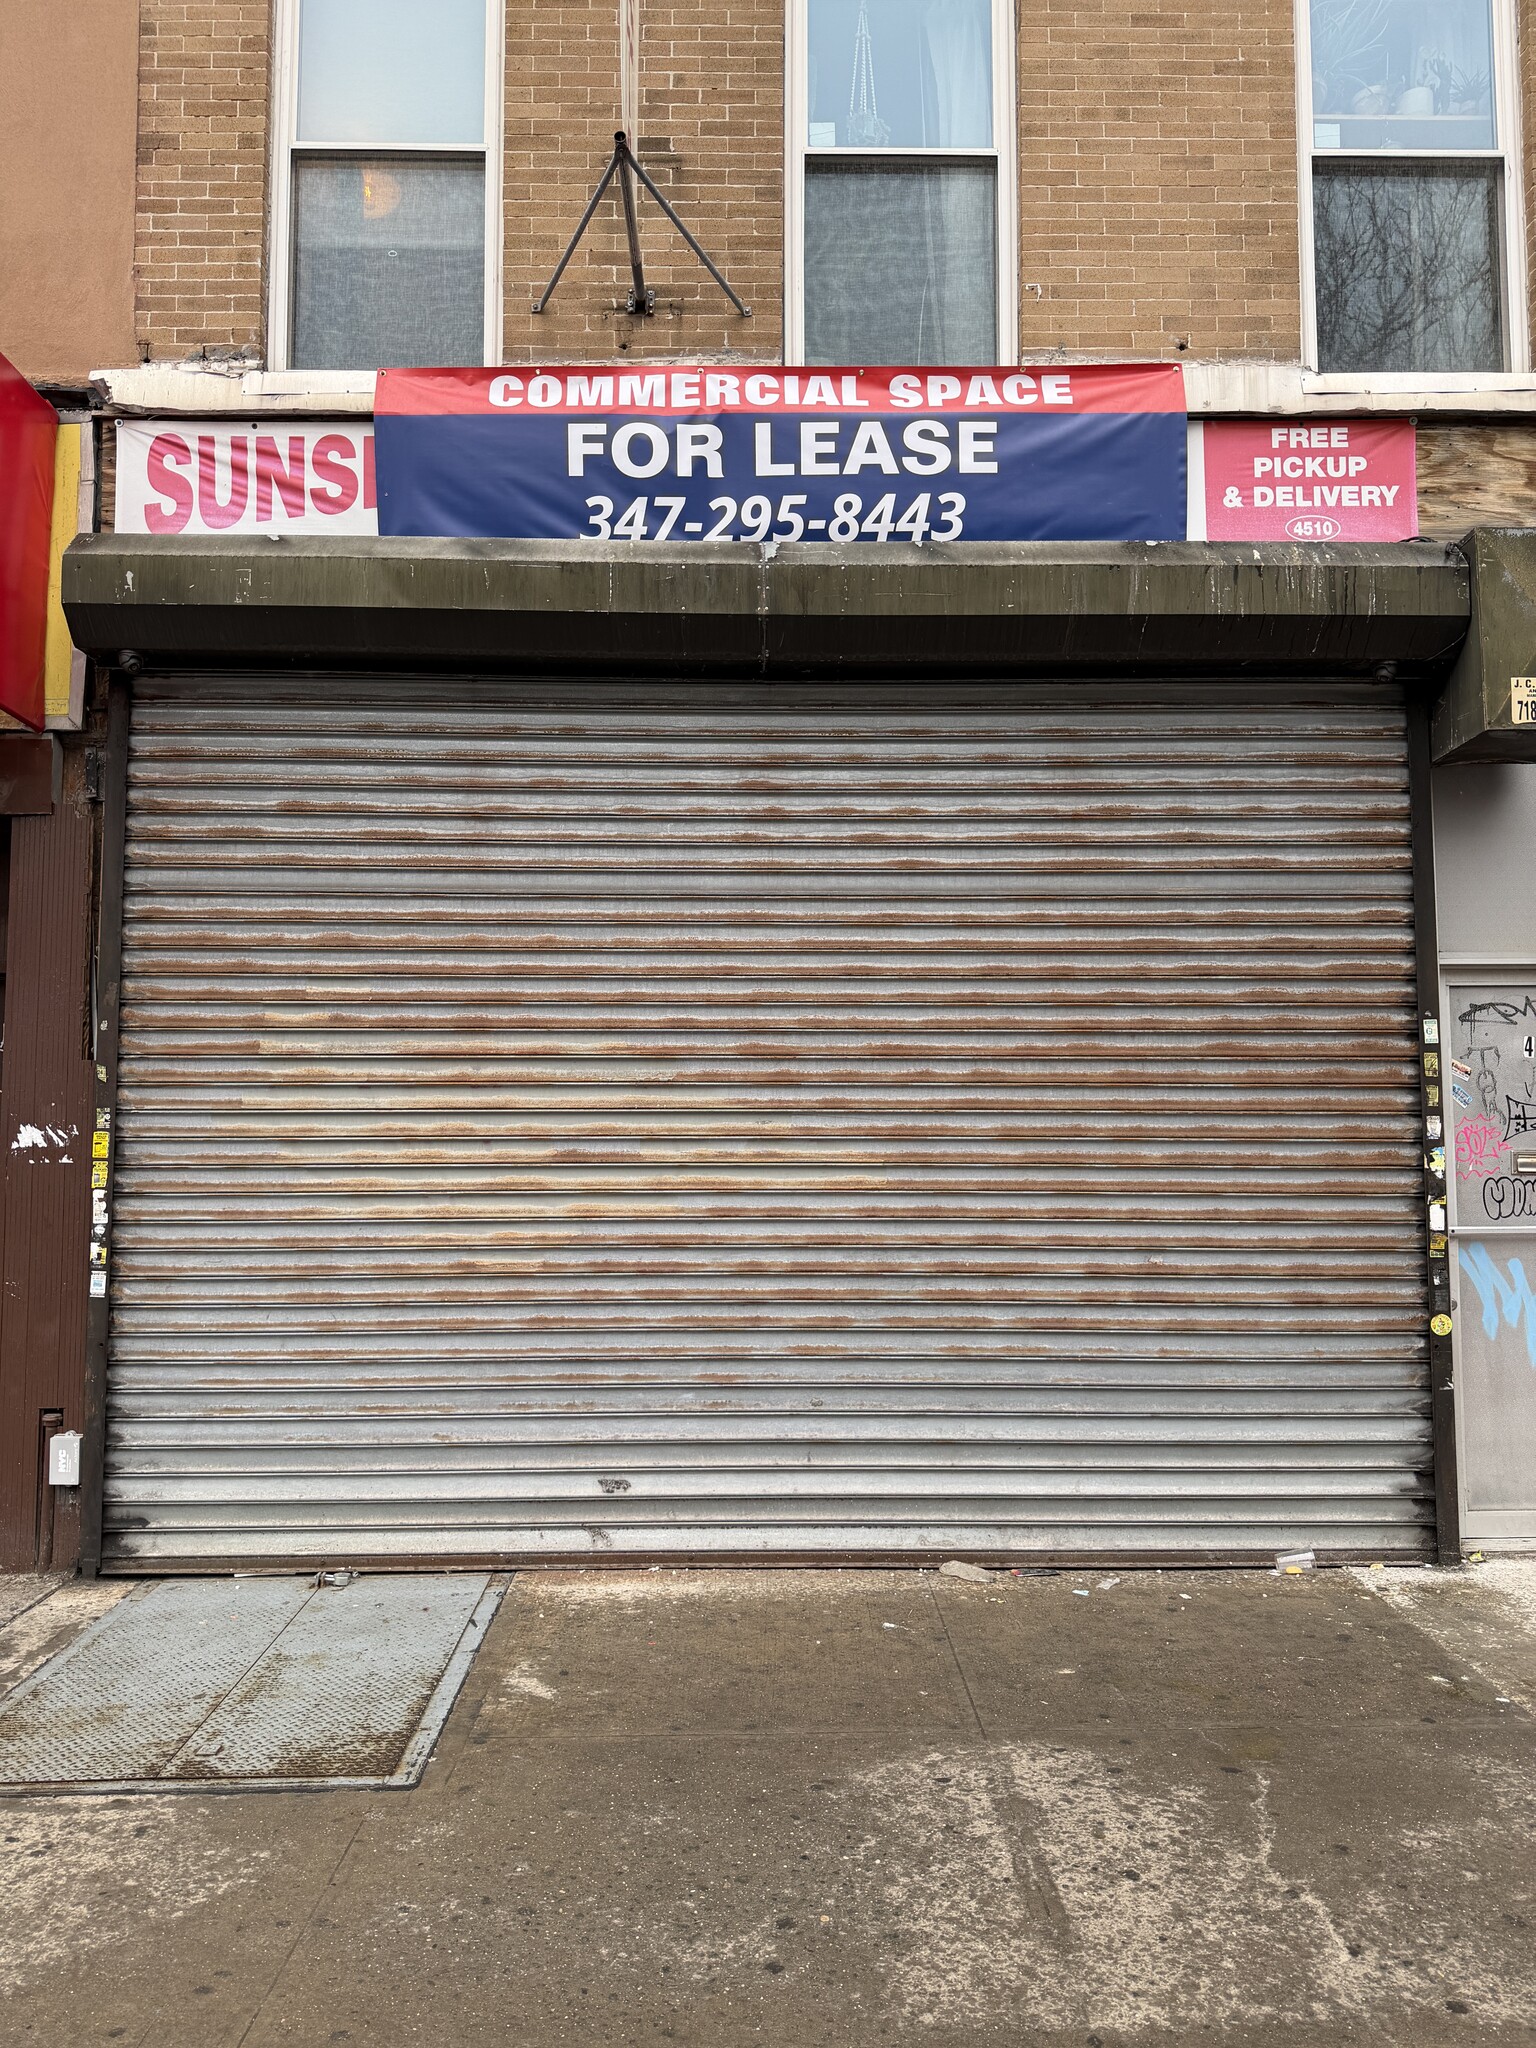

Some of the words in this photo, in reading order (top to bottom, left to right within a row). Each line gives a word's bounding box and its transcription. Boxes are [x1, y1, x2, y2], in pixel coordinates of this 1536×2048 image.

[488, 373, 869, 408] COMMERCIAL
[889, 374, 1074, 408] SPACE
[567, 421, 725, 478] FOR
[754, 419, 999, 477] LEASE
[1270, 427, 1349, 449] FREE
[1253, 456, 1368, 478] PICKUP
[1222, 486, 1244, 508] &
[1253, 485, 1400, 507] DELIVERY
[579, 492, 967, 541] 347-295-8443
[1293, 520, 1333, 536] 4510
[1524, 1035, 1534, 1057] 4
